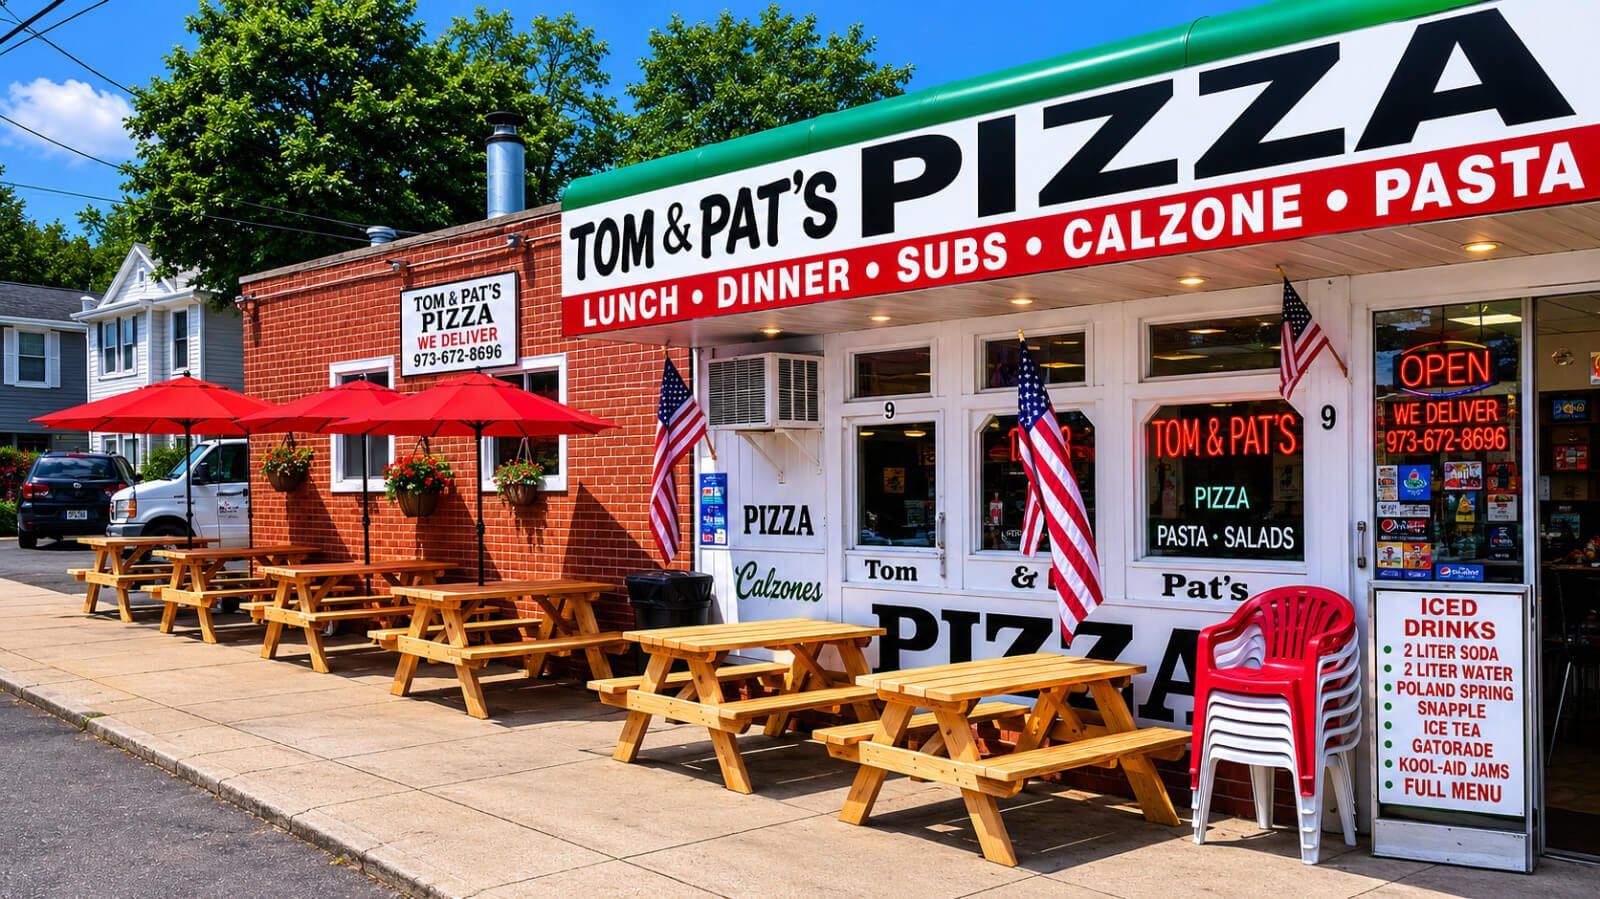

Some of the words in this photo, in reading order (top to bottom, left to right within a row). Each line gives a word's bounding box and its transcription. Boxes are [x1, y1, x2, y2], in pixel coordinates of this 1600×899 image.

[569, 208, 655, 281] TOM
[663, 201, 693, 255] &
[700, 169, 838, 259] PAT'S
[861, 7, 1576, 238] PIZZA
[583, 284, 679, 328] LUNCH
[717, 257, 850, 309] DINNER
[897, 232, 1008, 284] SUBS
[1063, 183, 1303, 259] CALZONE
[1375, 141, 1585, 216] PASTA
[414, 292, 445, 312] TOM
[448, 291, 458, 306] &
[461, 283, 502, 304] PAT'S
[422, 303, 494, 333] PIZZA
[417, 335, 437, 350] WE
[441, 327, 498, 347] DELIVER
[414, 344, 502, 367] 973-672-8696
[1400, 350, 1490, 387] OPEN
[884, 401, 895, 420] 9
[1321, 404, 1337, 430] 9
[1394, 402, 1421, 425] WE
[1426, 399, 1498, 424] DELIVER
[1152, 417, 1199, 458] TOM
[1206, 417, 1224, 456] &
[1231, 413, 1297, 455] PAT'S
[1386, 426, 1507, 453] 973-672-8696
[1195, 486, 1250, 509] PIZZA
[743, 504, 815, 536] PIZZA
[1157, 525, 1208, 547] PASTA
[1224, 526, 1294, 550] SALADS
[735, 560, 823, 603] Calzones
[864, 559, 918, 582] Tom
[1011, 565, 1039, 589] &
[1161, 573, 1249, 601] Pat's
[1421, 597, 1478, 617] ICED
[1404, 619, 1496, 640] DRINKS
[1404, 643, 1413, 658] 2
[1417, 644, 1456, 659] LITER
[1460, 645, 1499, 661] SODA
[1404, 662, 1413, 676] 2
[1417, 663, 1458, 679] LITER
[1462, 665, 1513, 682] WATER
[1397, 681, 1456, 697] POLAND
[1460, 683, 1514, 701] SPRING
[1417, 700, 1486, 719] SNAPPLE
[1424, 720, 1448, 736] ICE
[1452, 722, 1481, 738] TEA
[1412, 738, 1494, 758] GATORADE
[1399, 757, 1467, 776] KOOL-AID
[1471, 763, 1510, 780] JAMS
[1404, 778, 1446, 798] FULL
[1452, 782, 1502, 803] MENU
